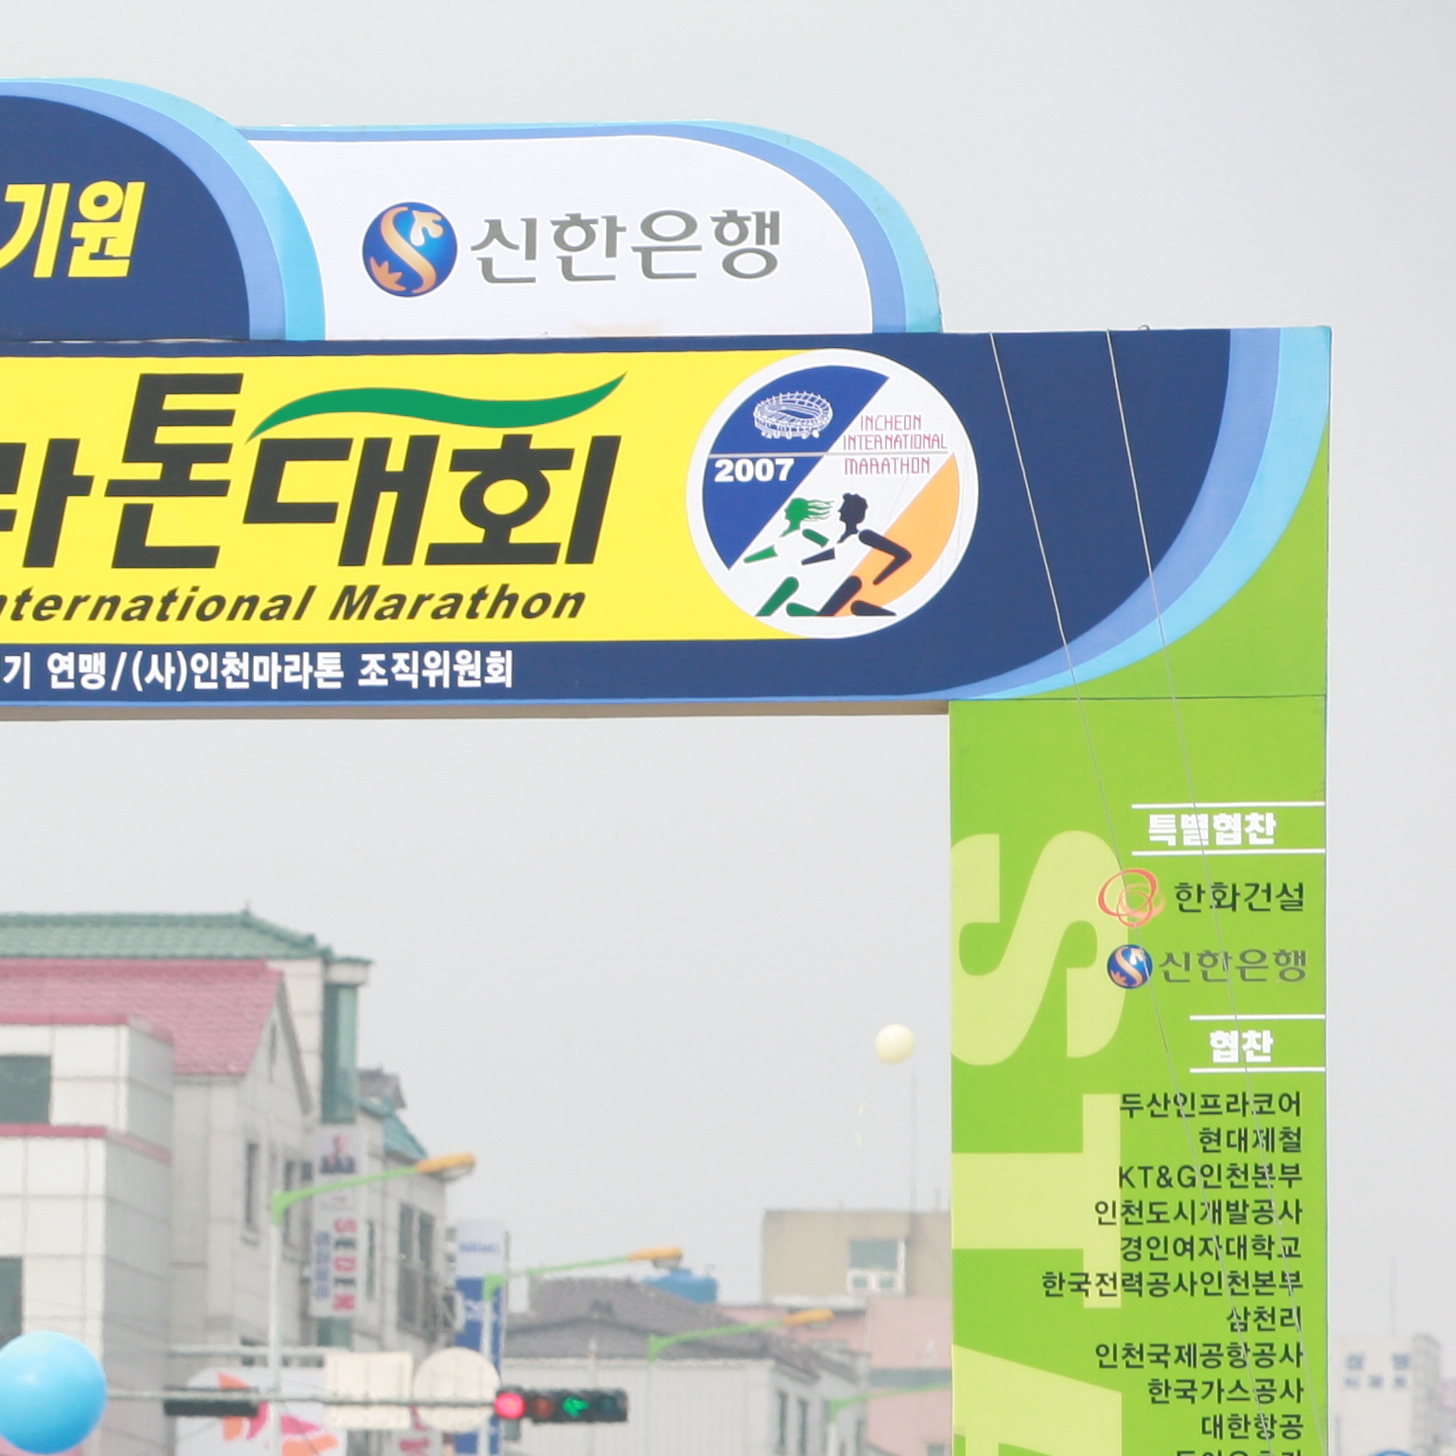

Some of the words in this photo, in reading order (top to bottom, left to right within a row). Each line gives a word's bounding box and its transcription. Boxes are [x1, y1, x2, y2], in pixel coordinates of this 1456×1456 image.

[470, 208, 783, 284] 신한은행
[861, 414, 922, 431] INCHEON
[843, 434, 948, 451] INTERNATIONAL
[714, 458, 795, 482] 2007
[845, 457, 931, 475] MARATHON
[338, 584, 587, 620] Marathon
[357, 650, 514, 689] 조직위원회
[1148, 813, 1276, 846] 특별협찬
[1174, 881, 1304, 912] 한화건설
[1158, 949, 1308, 983] 신한은행
[1210, 1030, 1274, 1063] 협찬
[1120, 1091, 1302, 1119] 두산인프라코어
[1199, 1127, 1302, 1153] 현대제철
[1119, 1163, 1303, 1190] KT&G인천본부
[1094, 1199, 1303, 1226] 인천도시개발공사
[1120, 1235, 1302, 1262] 경인여자대학교
[1042, 1271, 1303, 1298] 한국전력공사인천본부
[1226, 1306, 1302, 1333] 삼천리
[1095, 1343, 1303, 1369] 인천국제공항공사
[1148, 1378, 1304, 1404] 한국가스공사
[1201, 1414, 1304, 1440] 대한항공
